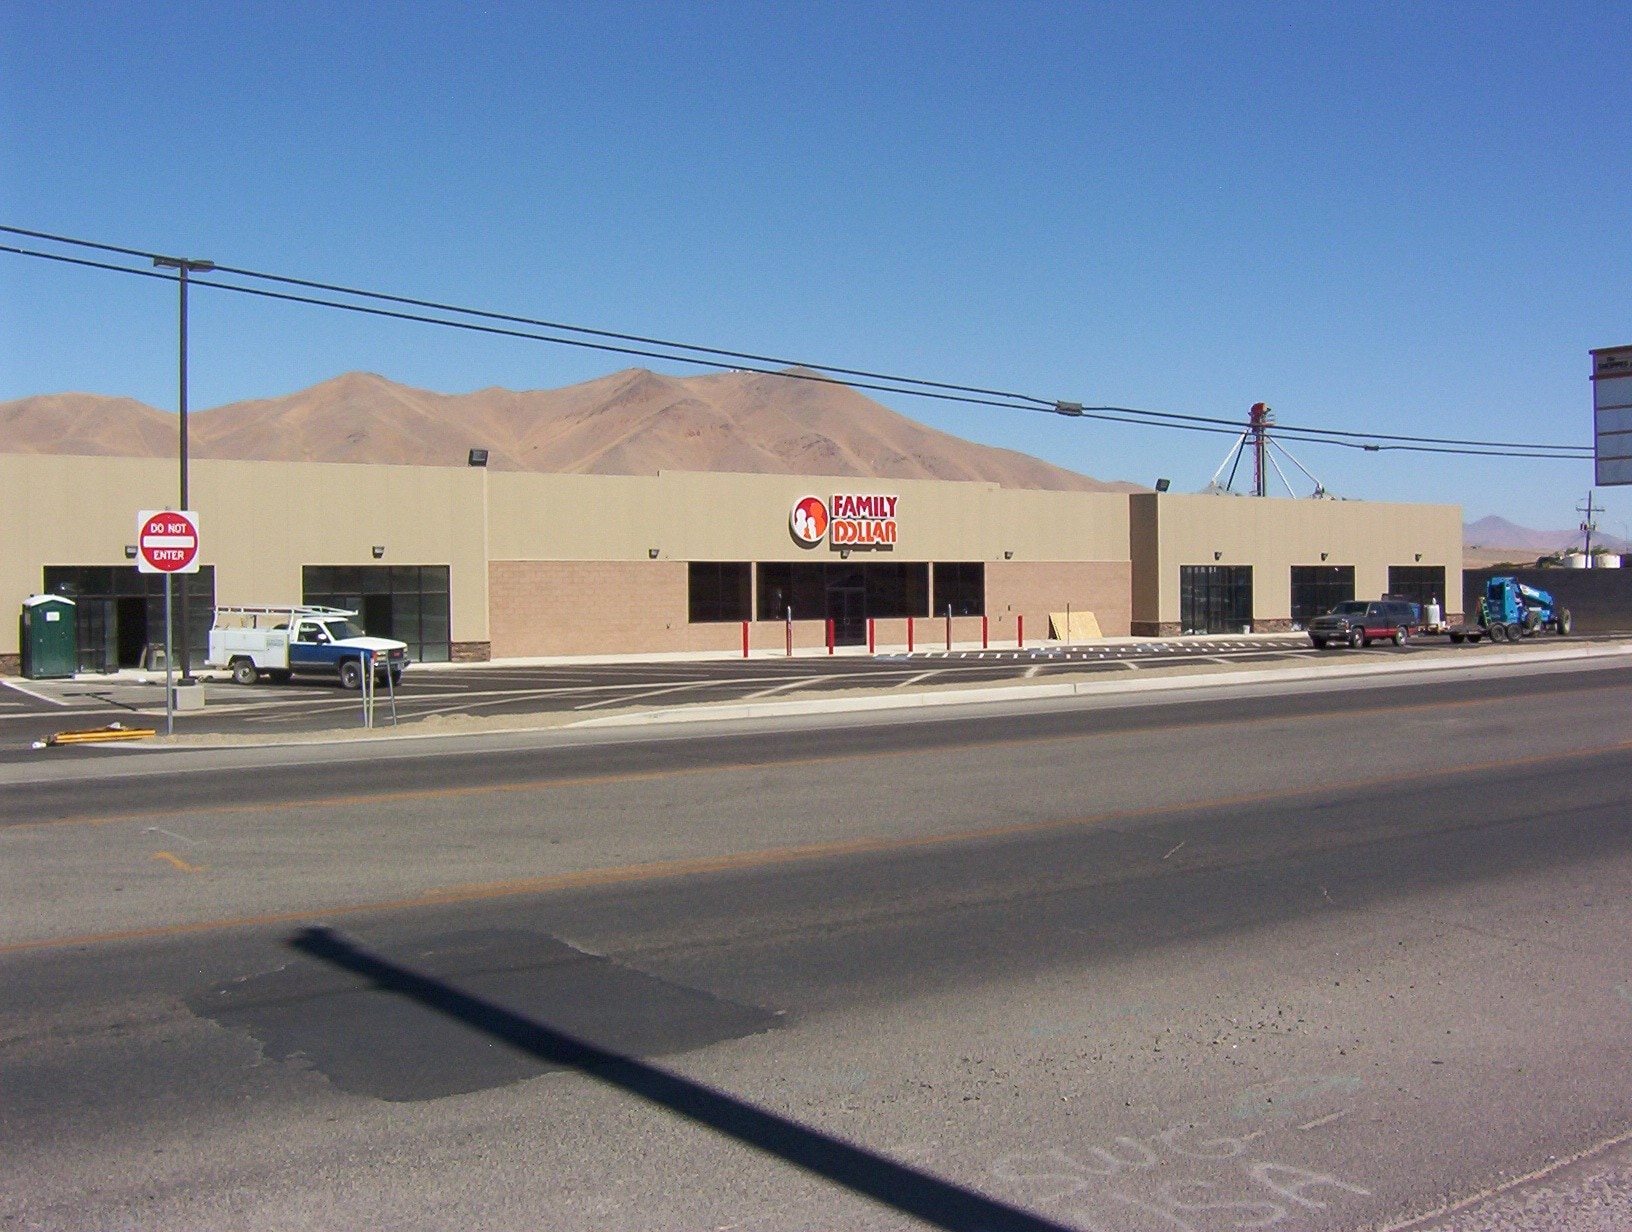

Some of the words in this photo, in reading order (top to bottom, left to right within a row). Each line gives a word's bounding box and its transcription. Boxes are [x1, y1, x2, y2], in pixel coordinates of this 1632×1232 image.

[834, 495, 898, 517] FAMILY
[150, 523, 164, 533] DO
[167, 523, 187, 533] NOT
[834, 520, 897, 543] DOLLAR
[153, 550, 185, 560] ENTER
